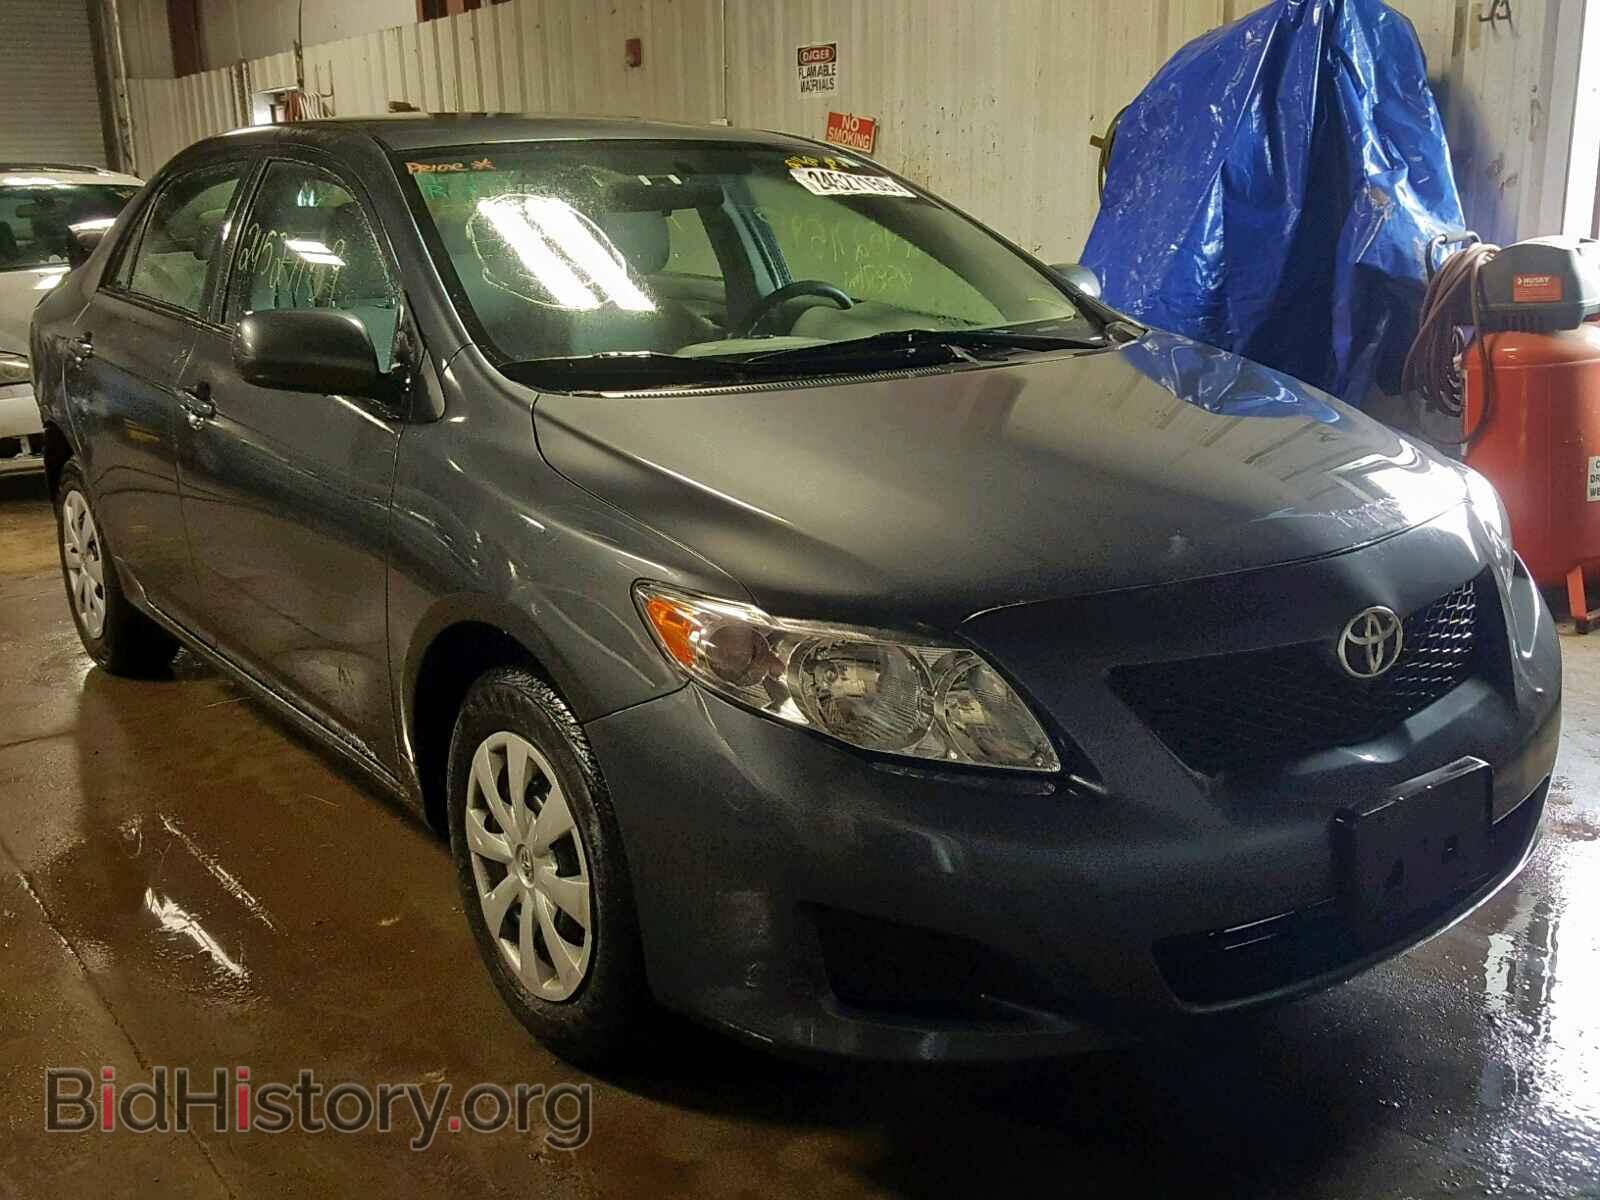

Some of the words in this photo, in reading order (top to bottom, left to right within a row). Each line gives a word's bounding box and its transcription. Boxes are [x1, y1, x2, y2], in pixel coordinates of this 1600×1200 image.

[802, 49, 830, 61] DGER
[799, 64, 836, 79] FLAMABLE
[801, 78, 835, 92] MARIALS
[841, 115, 860, 131] NO
[828, 126, 870, 149] SMOKING
